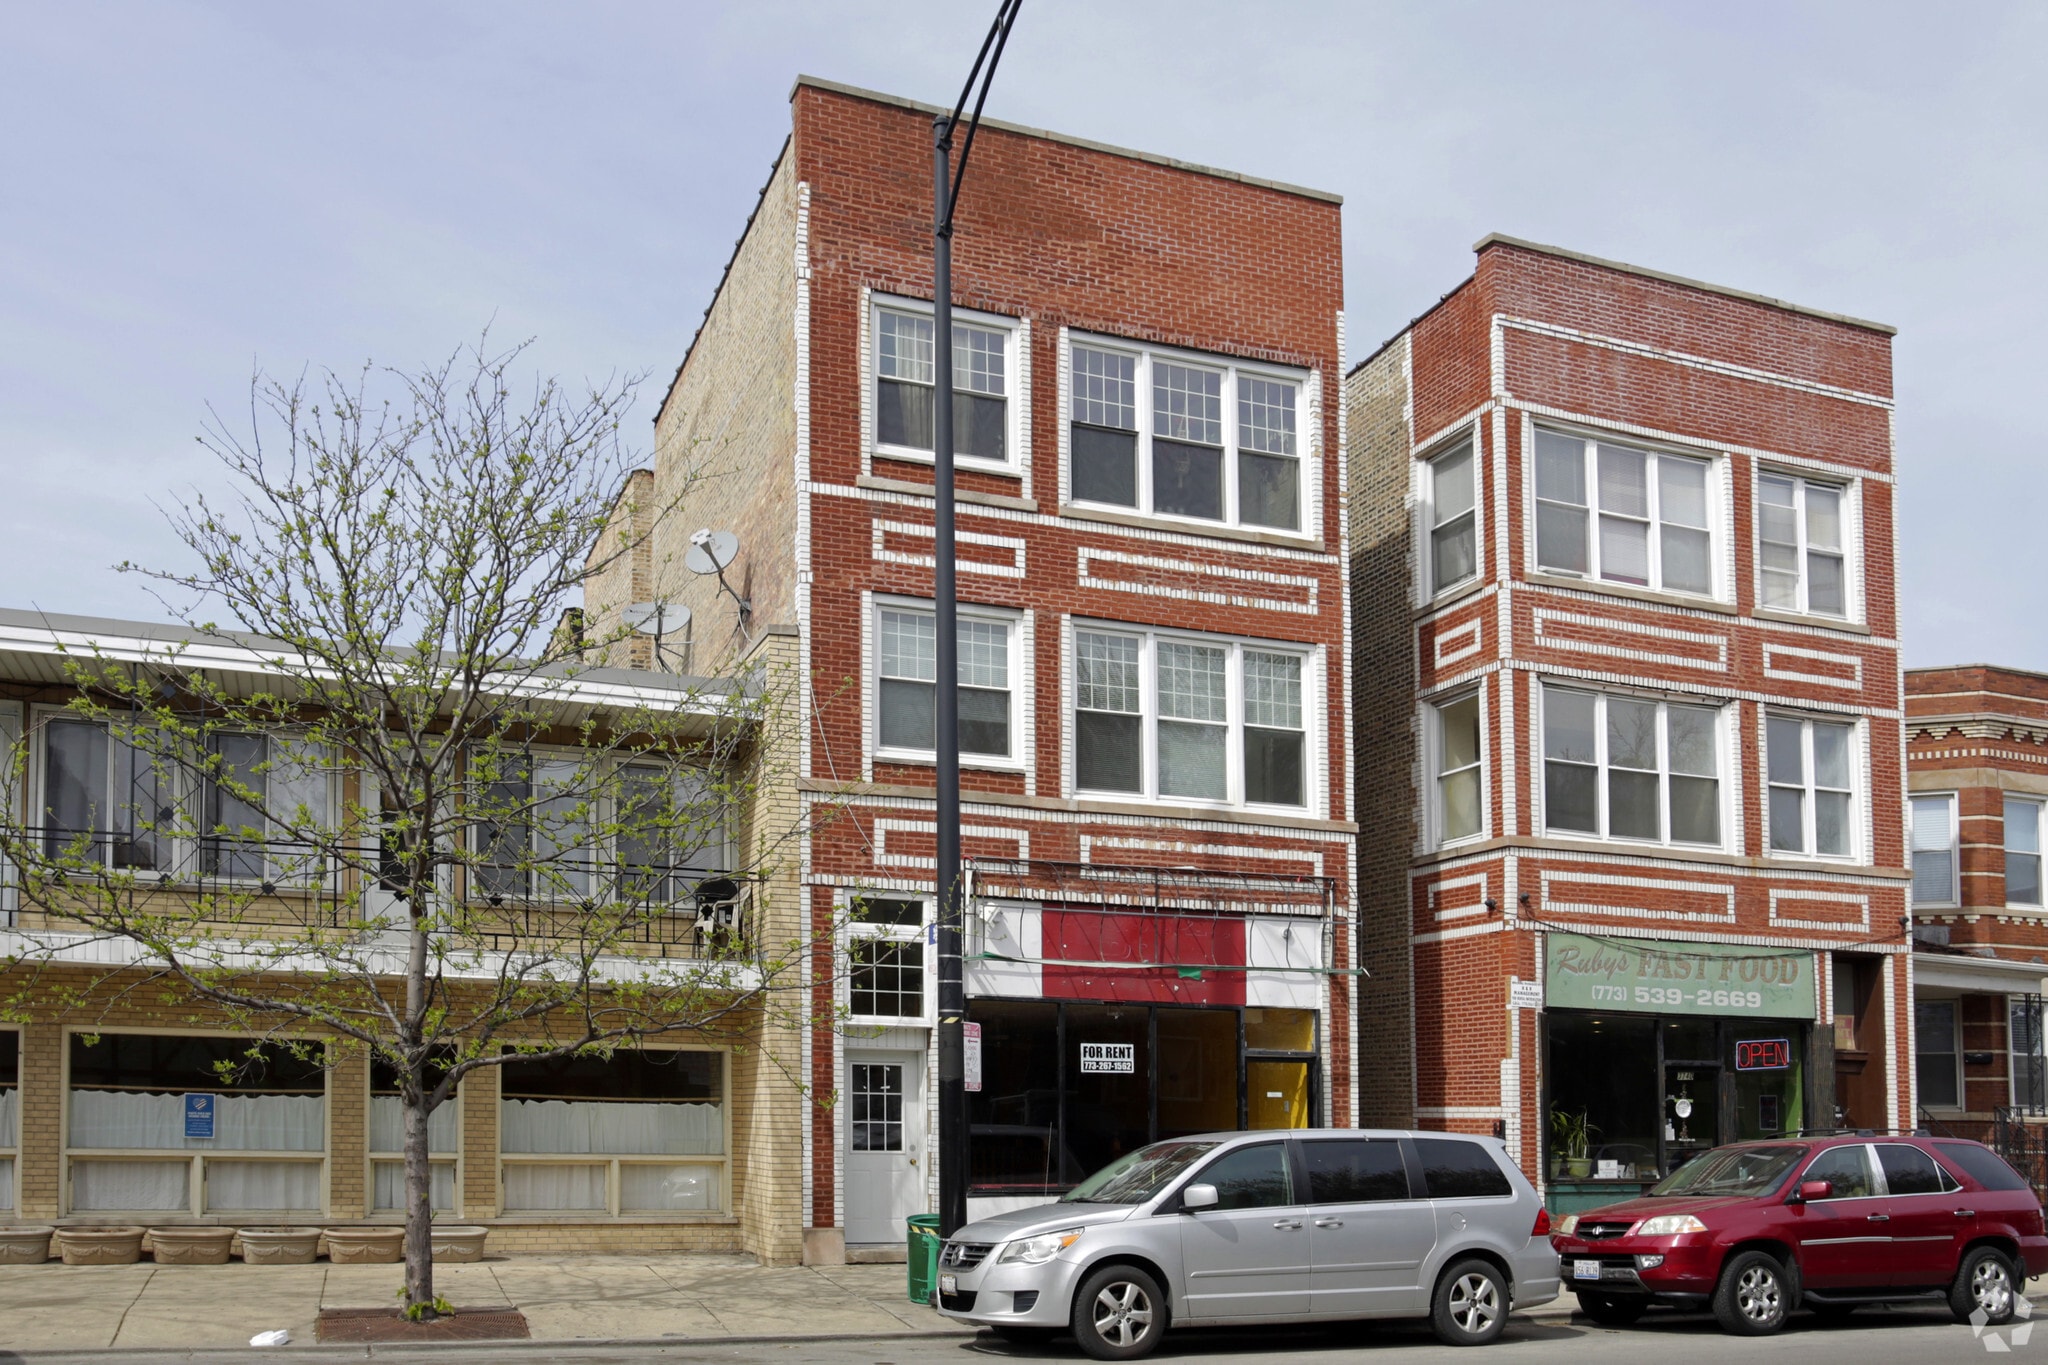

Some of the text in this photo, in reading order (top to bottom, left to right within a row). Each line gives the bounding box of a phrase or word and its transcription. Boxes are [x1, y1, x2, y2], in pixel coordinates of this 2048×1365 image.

[1557, 944, 1799, 985] Ruby's FAST FOOD
[1591, 984, 1762, 1008] (773) 539-2669
[1083, 1046, 1132, 1059] FOR RENT
[1738, 1042, 1787, 1068] OPEN
